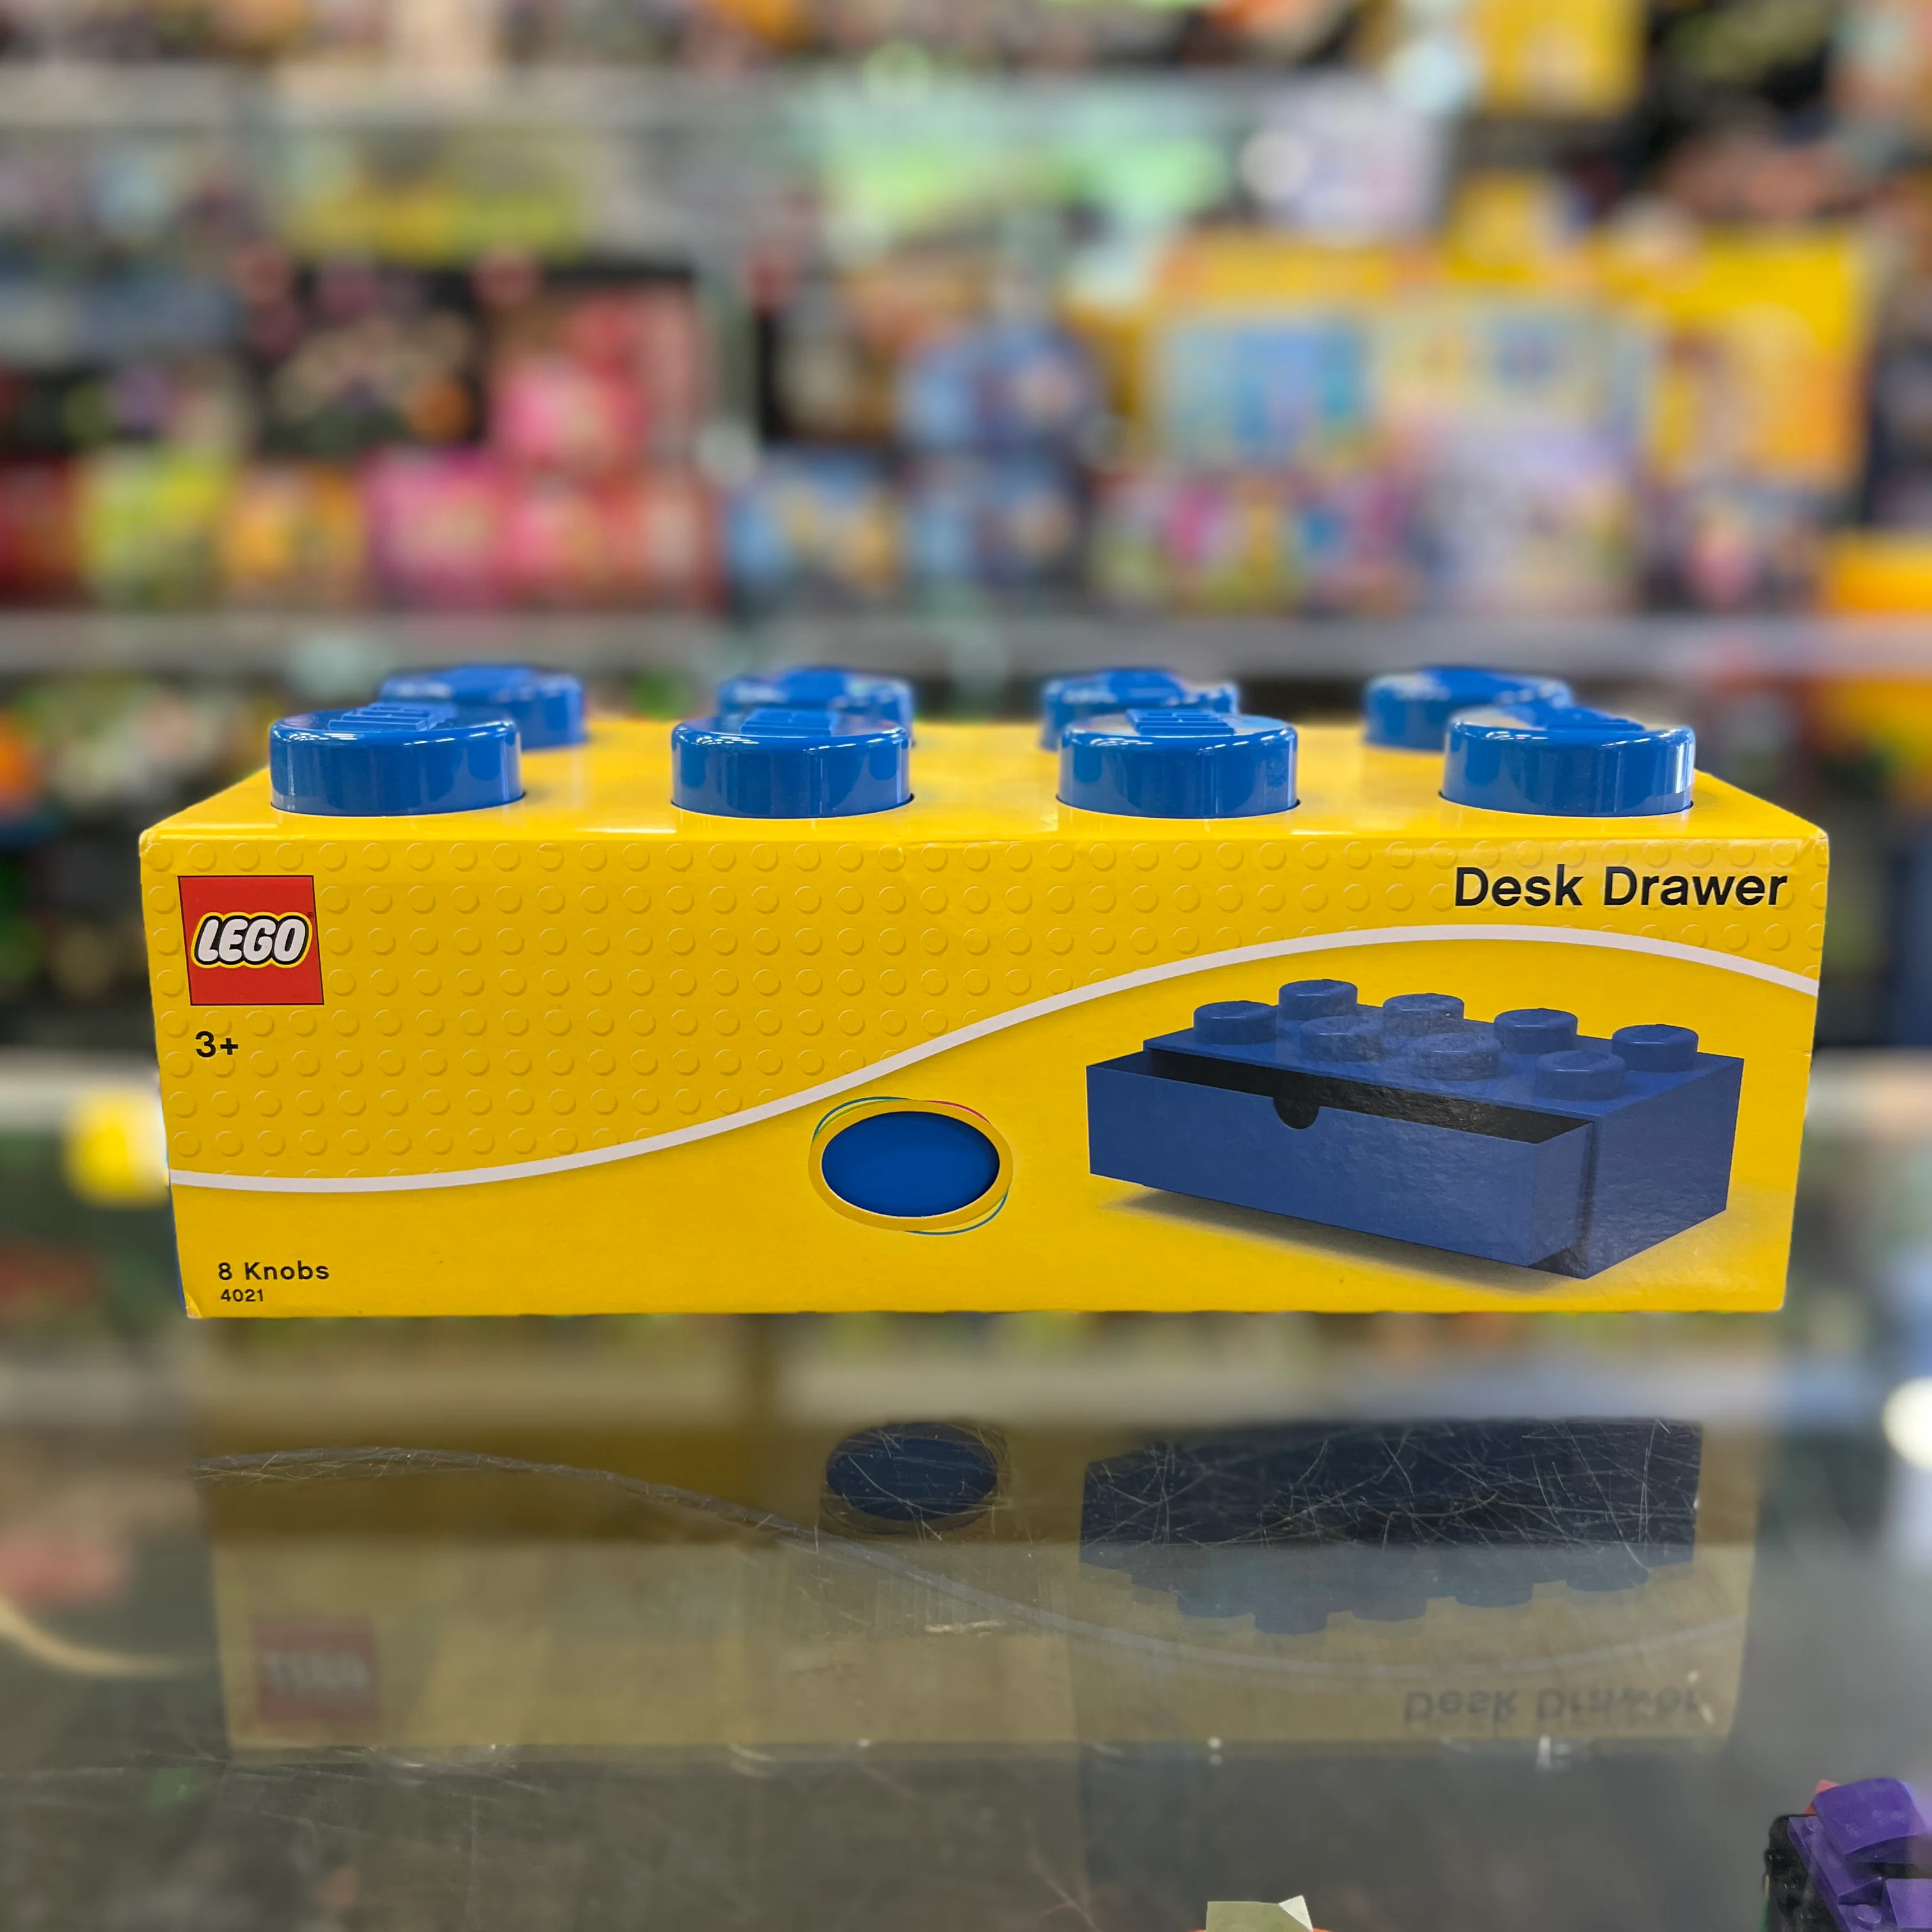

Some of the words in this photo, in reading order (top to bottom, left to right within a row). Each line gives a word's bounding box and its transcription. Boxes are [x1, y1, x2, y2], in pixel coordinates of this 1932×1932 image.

[1454, 863, 1584, 907] Desk
[1604, 866, 1788, 907] Drawer
[194, 915, 310, 965] LEGO
[195, 1030, 240, 1059] 3+
[218, 1261, 233, 1281] 8
[244, 1260, 330, 1281] Knobs
[220, 1288, 264, 1303] 4021
